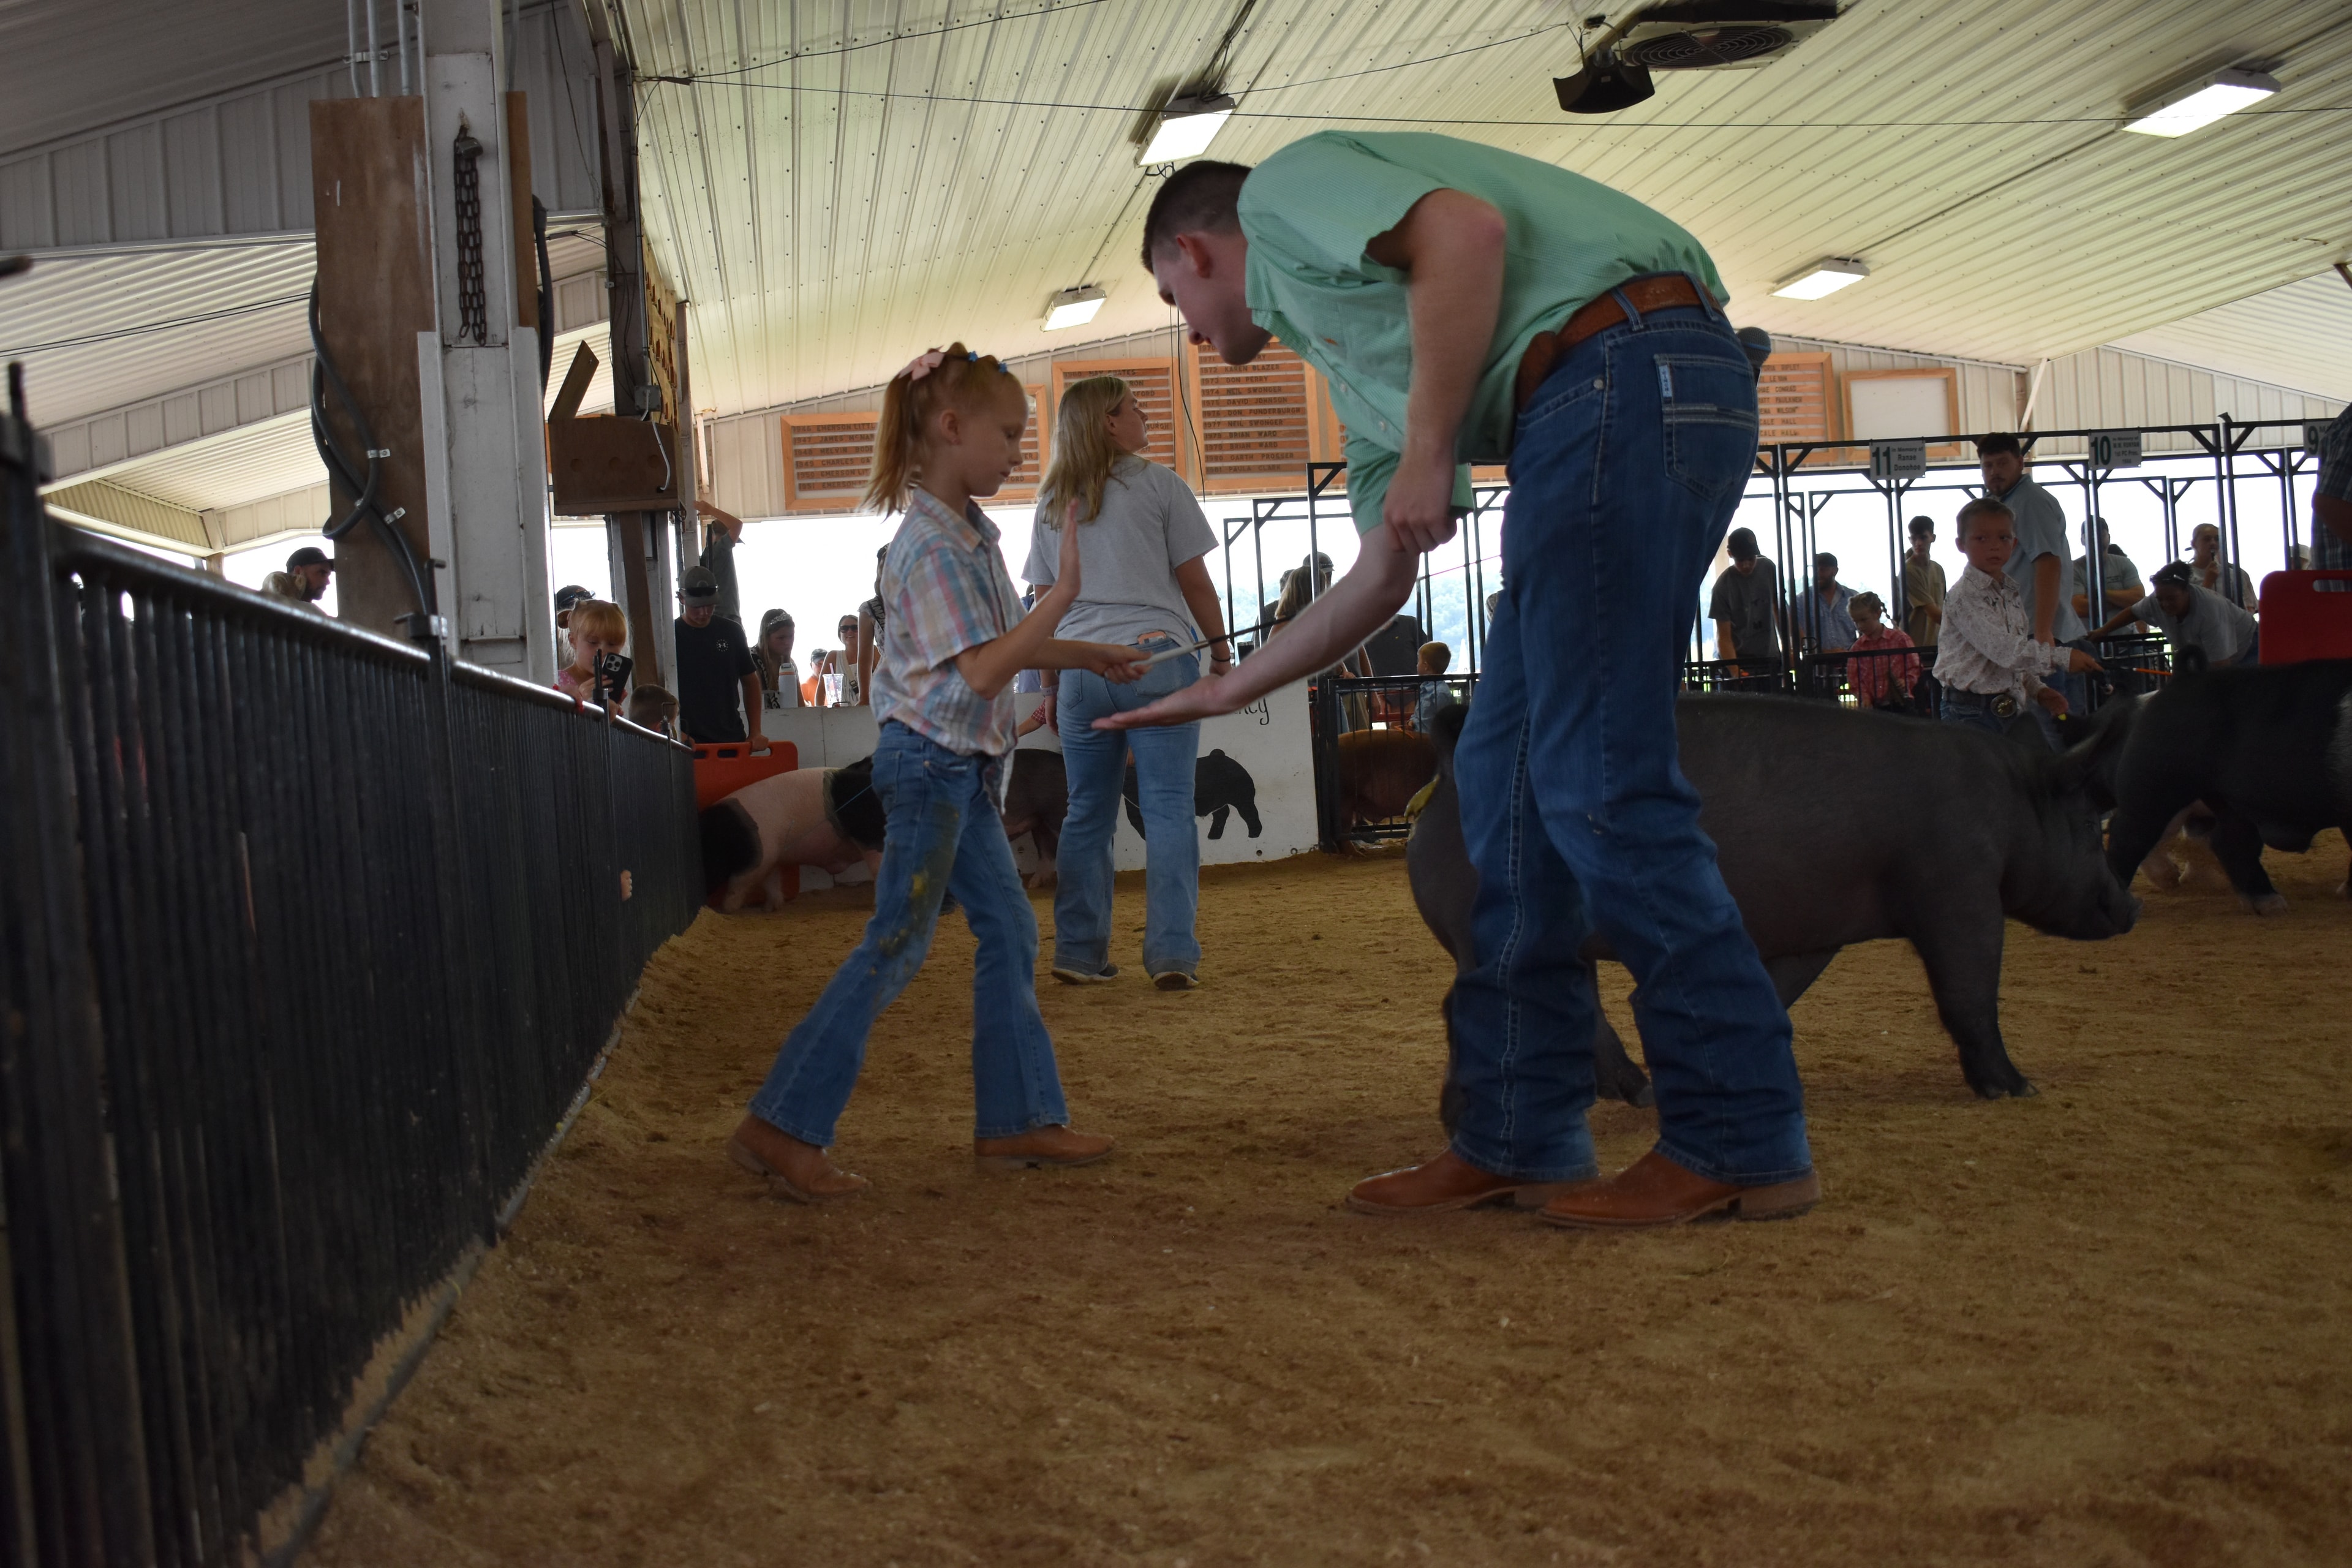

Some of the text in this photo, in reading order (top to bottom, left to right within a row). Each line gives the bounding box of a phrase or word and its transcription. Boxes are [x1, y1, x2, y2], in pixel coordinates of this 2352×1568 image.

[2090, 436, 2111, 466] 10
[2307, 426, 2319, 454] 9
[1872, 447, 1891, 476] 11
